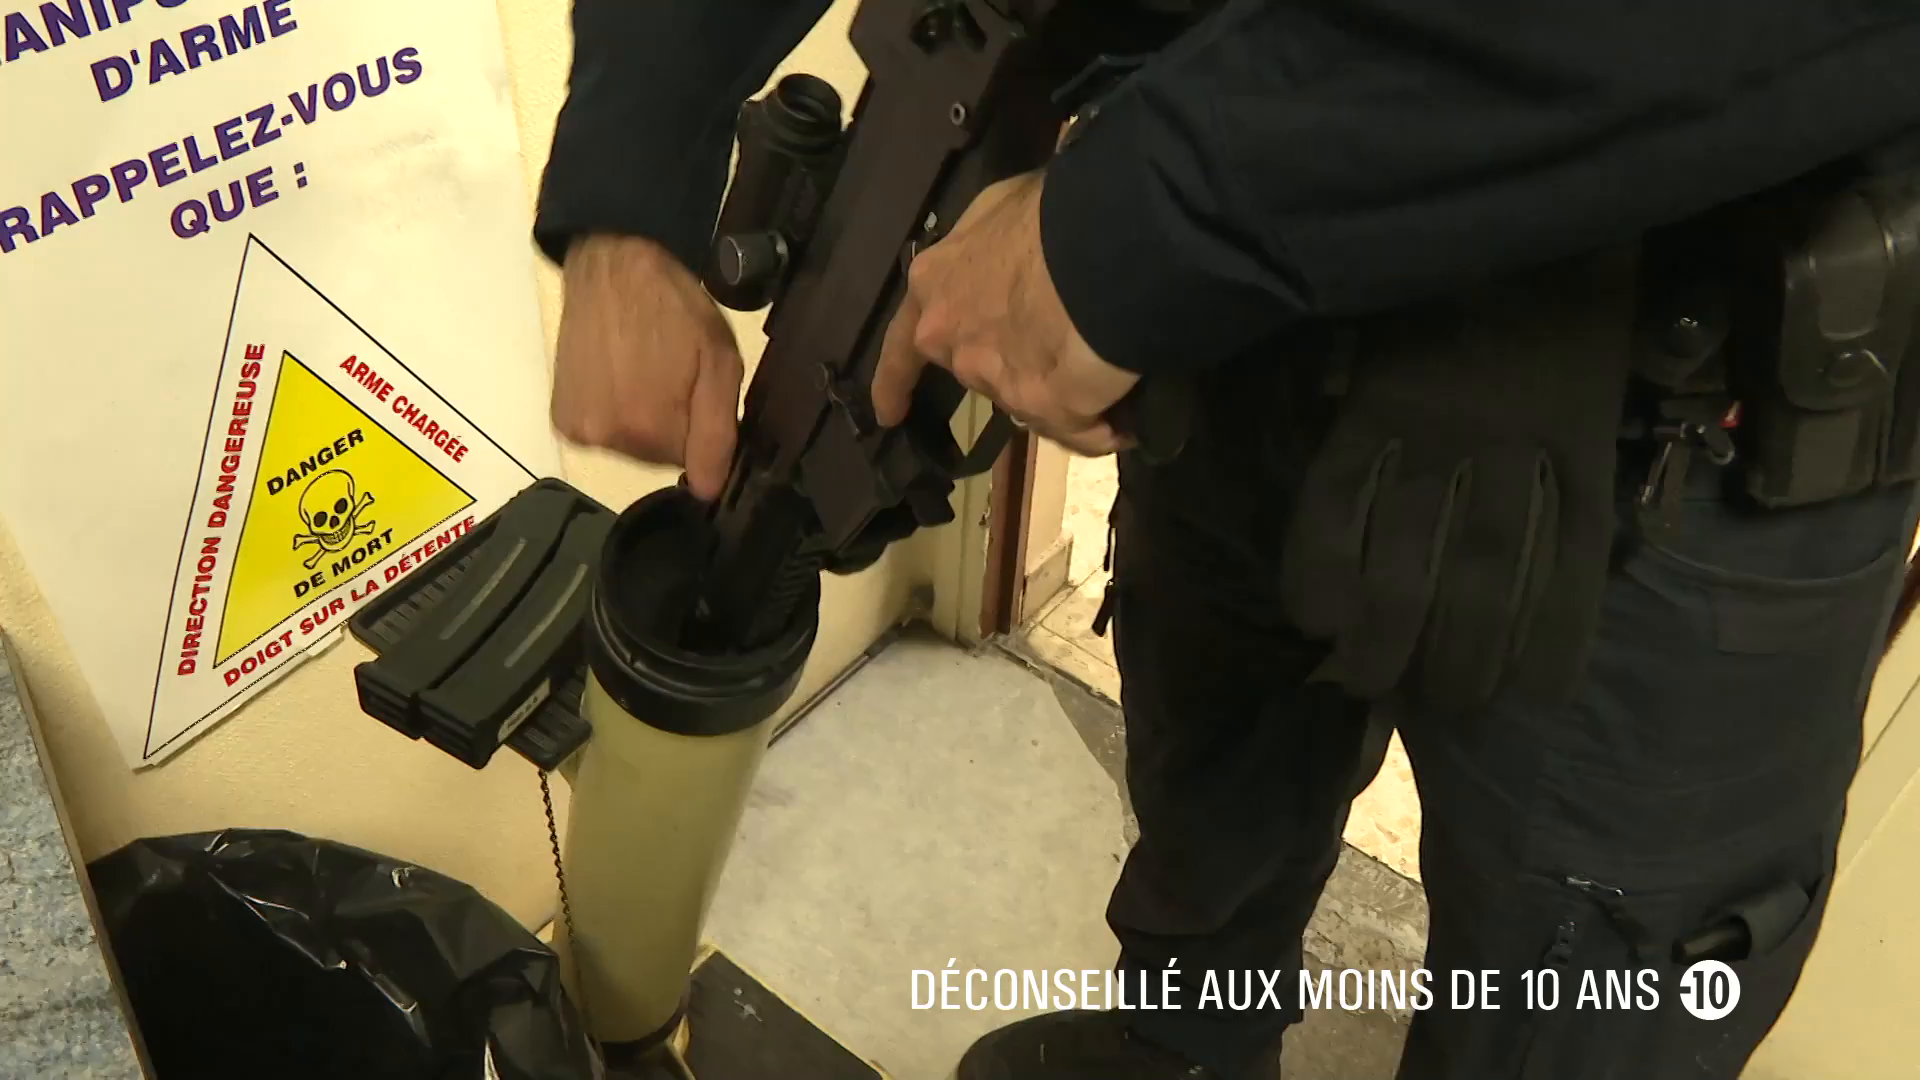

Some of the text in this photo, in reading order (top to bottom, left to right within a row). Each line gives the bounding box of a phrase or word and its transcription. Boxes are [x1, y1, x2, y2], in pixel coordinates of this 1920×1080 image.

[0, 0, 188, 66] ANIP
[90, 0, 298, 103] D'ARME
[0, 47, 423, 253] RAPPELEZ-VOUS
[170, 165, 279, 240] QUE
[339, 354, 469, 463] ARME CHARGÉE
[177, 343, 265, 675] DIRECTION DANGEREUSE
[266, 428, 365, 496] DANGER
[223, 515, 476, 687] DOIGT SUR LA DÉTENTE
[293, 528, 393, 598] DE MORT
